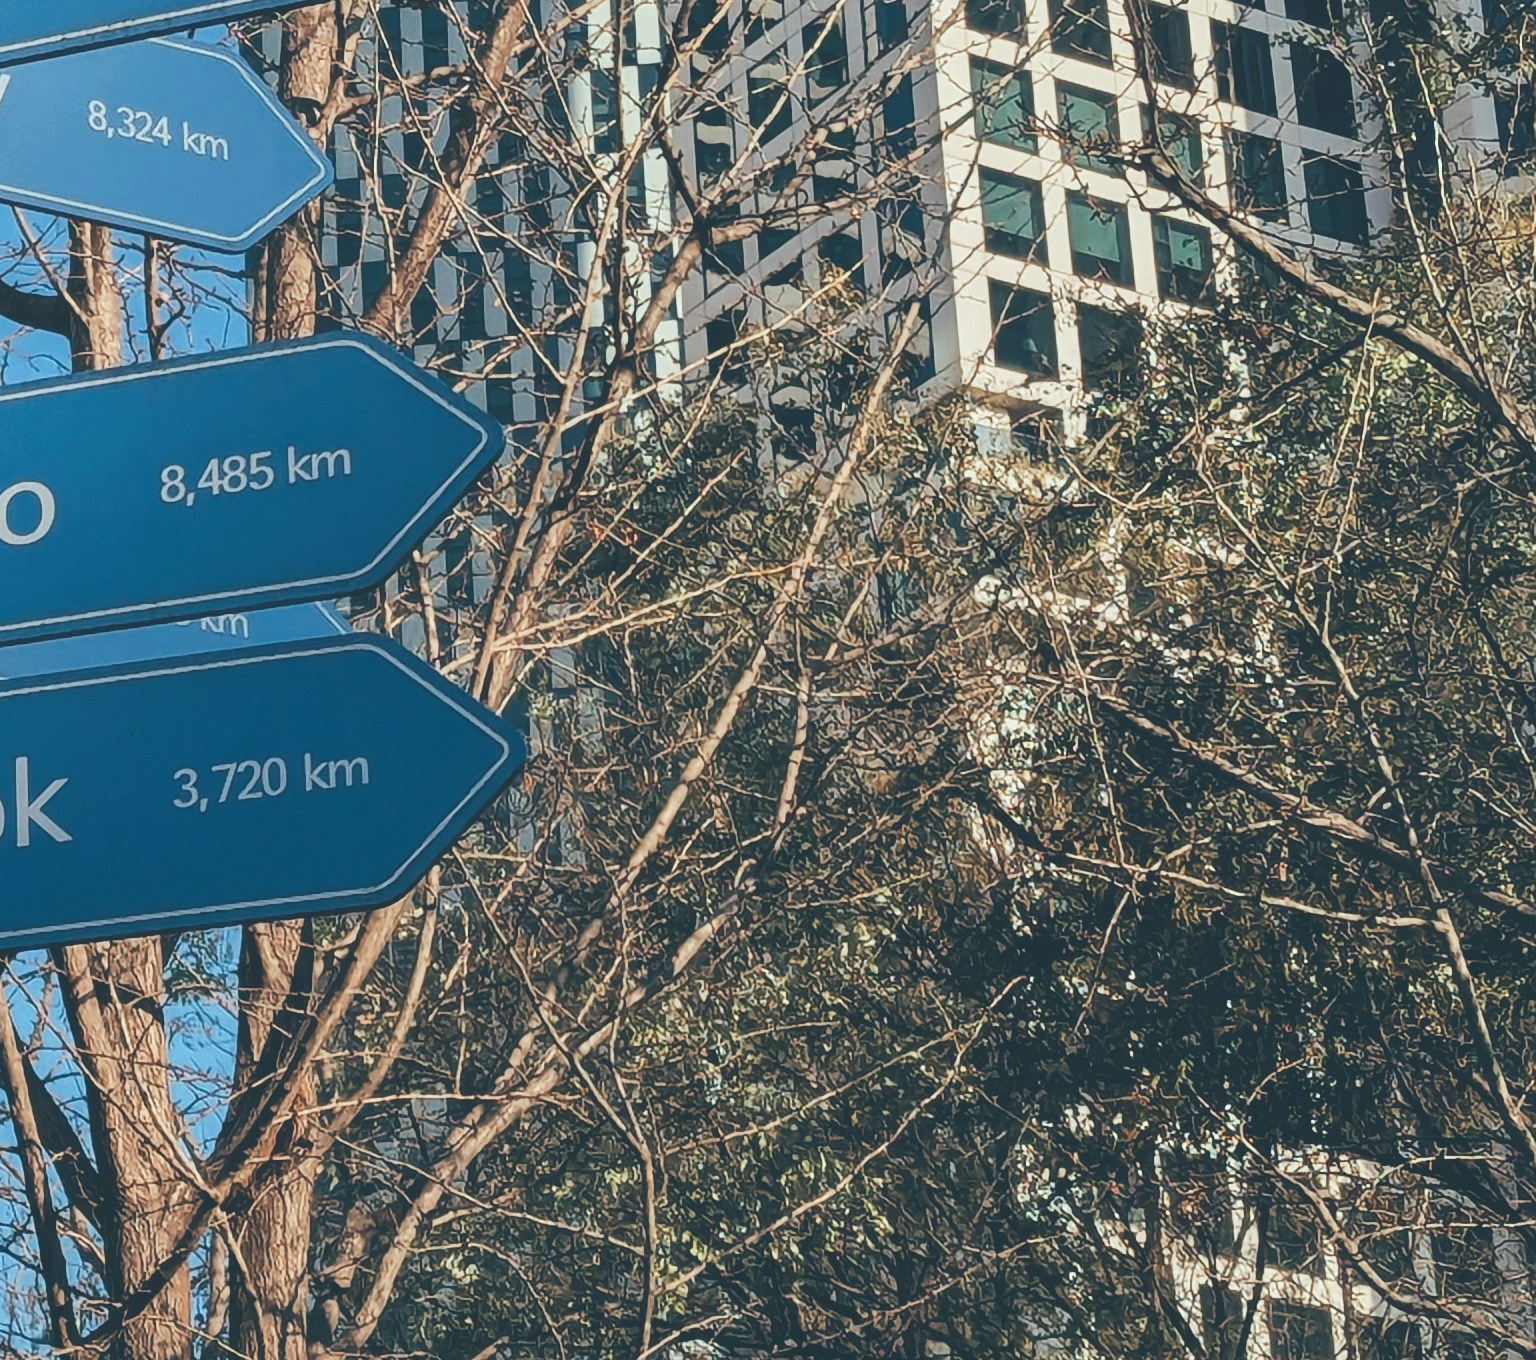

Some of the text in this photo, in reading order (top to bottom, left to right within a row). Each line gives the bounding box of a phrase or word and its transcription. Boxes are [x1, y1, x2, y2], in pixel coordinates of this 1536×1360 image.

[87, 100, 172, 146] 8,324
[182, 121, 230, 161] km
[160, 450, 275, 508] 8,485
[287, 445, 352, 482] km
[172, 757, 287, 813] 3,720
[304, 752, 370, 793] km
